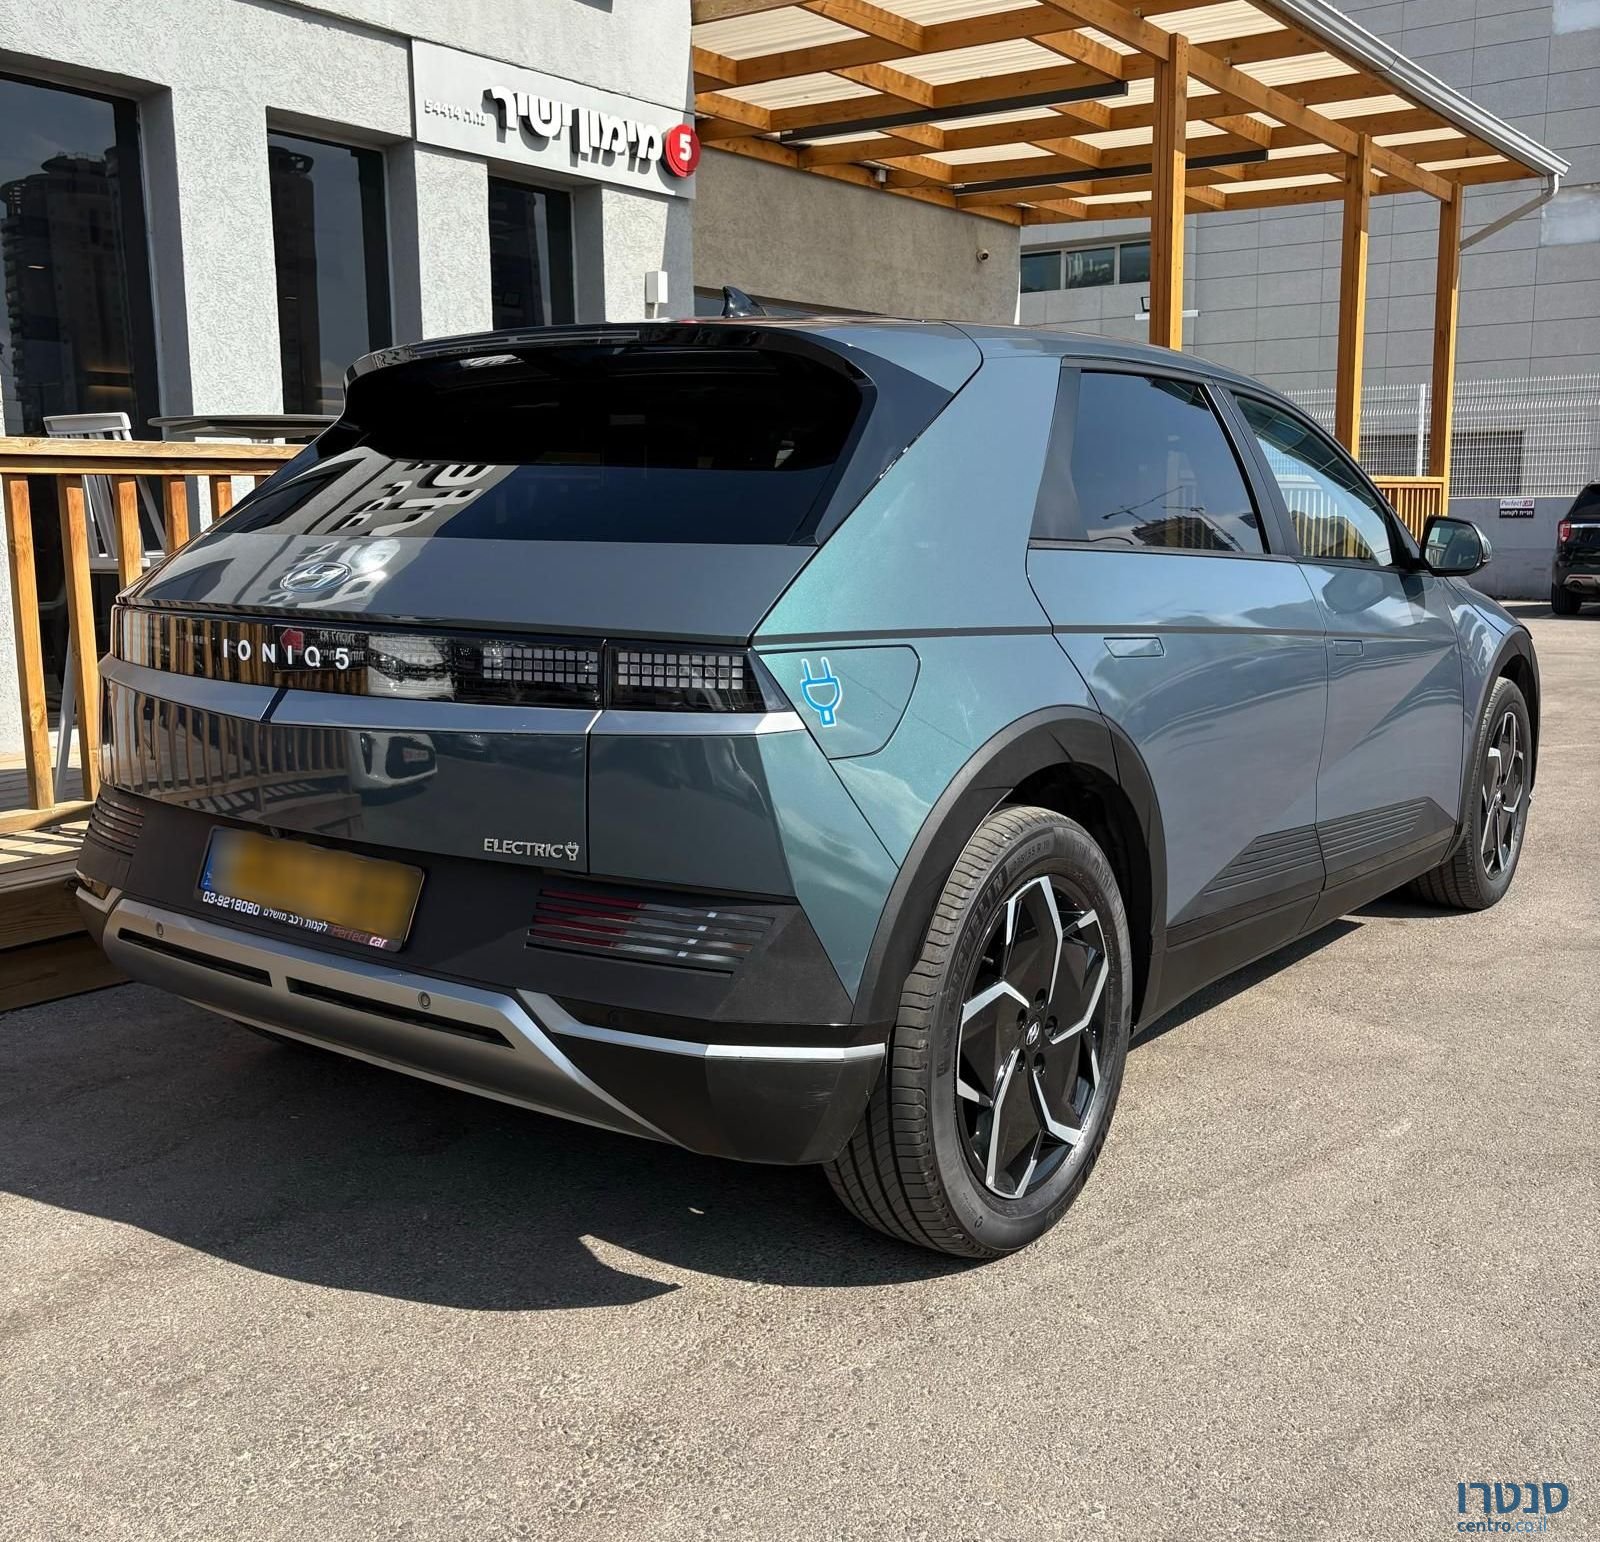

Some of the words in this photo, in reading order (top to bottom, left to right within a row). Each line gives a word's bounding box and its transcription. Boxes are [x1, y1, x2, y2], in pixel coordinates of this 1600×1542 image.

[424, 99, 461, 121] 54414
[483, 85, 573, 138] ישיר
[571, 107, 663, 161] מימון
[678, 131, 692, 161] 5
[223, 638, 321, 668] IONIQ
[335, 647, 349, 670] 5
[483, 837, 564, 858] ELECTRIC
[202, 891, 261, 916] 03-9218080
[263, 907, 287, 922] מושלם
[288, 914, 303, 926] רכב
[304, 919, 329, 932] לקנות
[331, 925, 368, 945] Perfect
[368, 936, 389, 949] car
